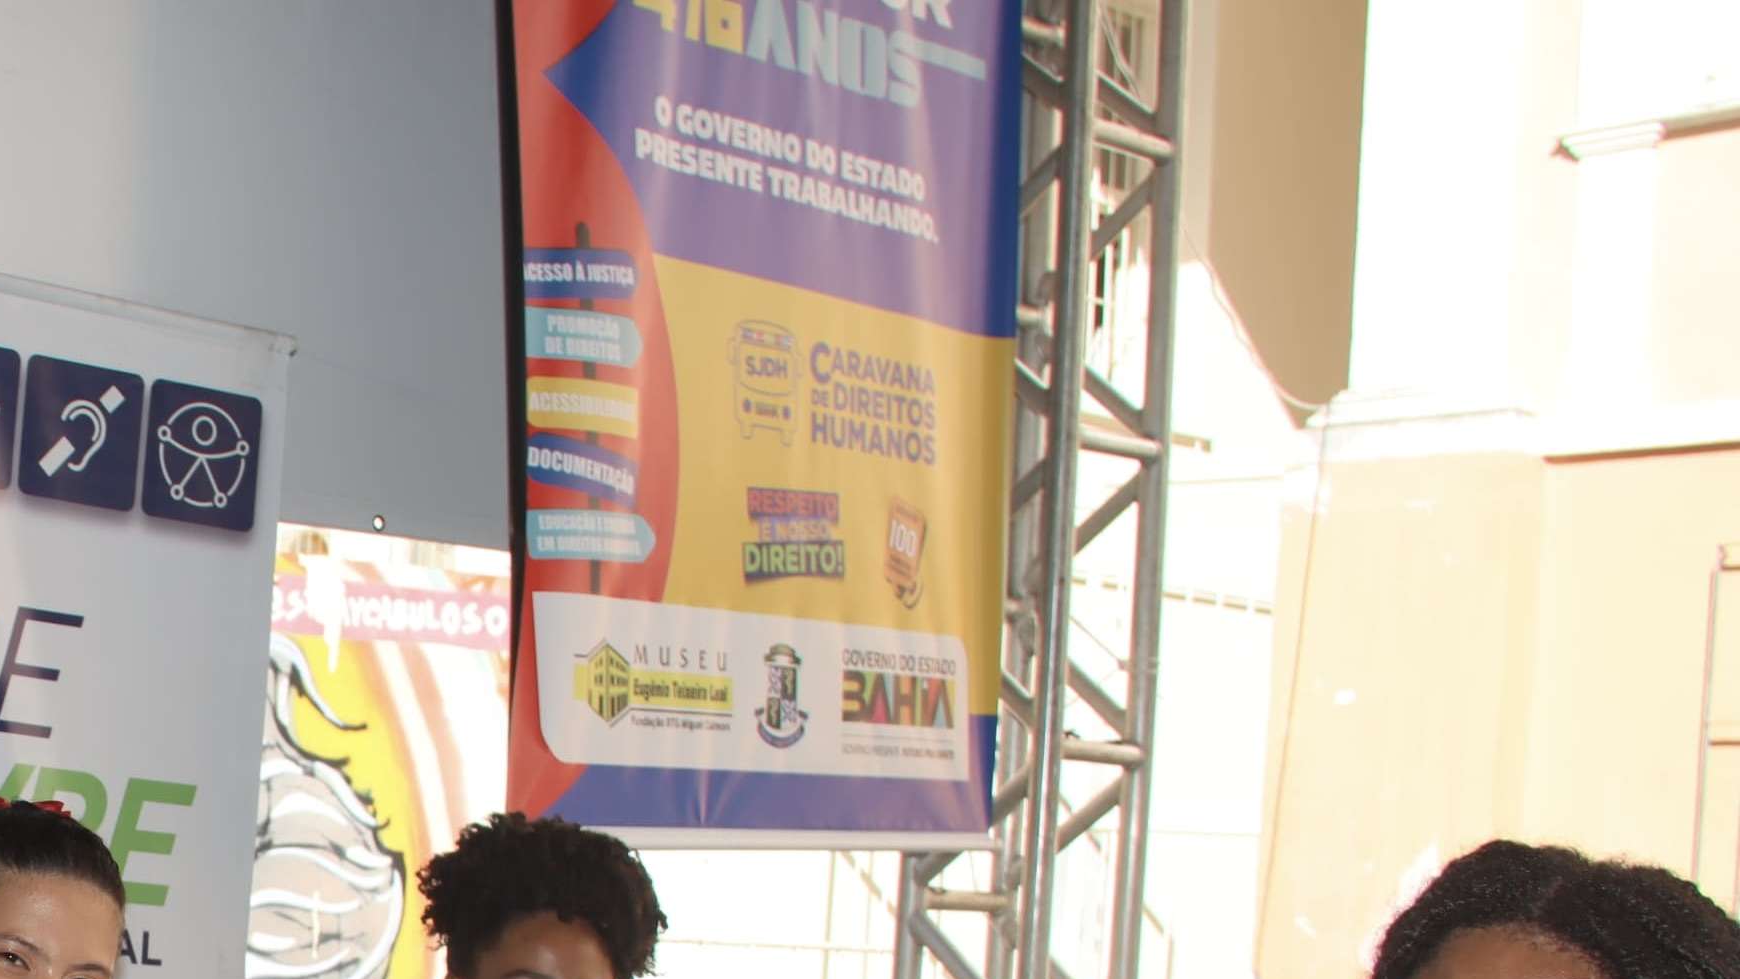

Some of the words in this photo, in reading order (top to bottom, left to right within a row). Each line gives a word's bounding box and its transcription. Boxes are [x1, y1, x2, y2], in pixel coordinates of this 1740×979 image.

[654, 96, 673, 127] O
[675, 105, 801, 164] GOVERNO
[805, 140, 837, 176] DO
[841, 153, 926, 201] ESTADO
[635, 128, 763, 193] PRESENTE
[768, 164, 941, 245] TRABALHANDO.
[745, 354, 788, 380] SJDH
[810, 341, 936, 397] CARAVANA
[832, 382, 936, 432] DIREITOS
[810, 411, 936, 466] HUMANOS
[744, 542, 844, 575] DIREITO!
[633, 644, 727, 671] MUSEU
[842, 648, 896, 671] GOVERNO
[900, 655, 916, 672] DO
[918, 655, 956, 676] ESTADO
[842, 669, 954, 729] BAHIA
